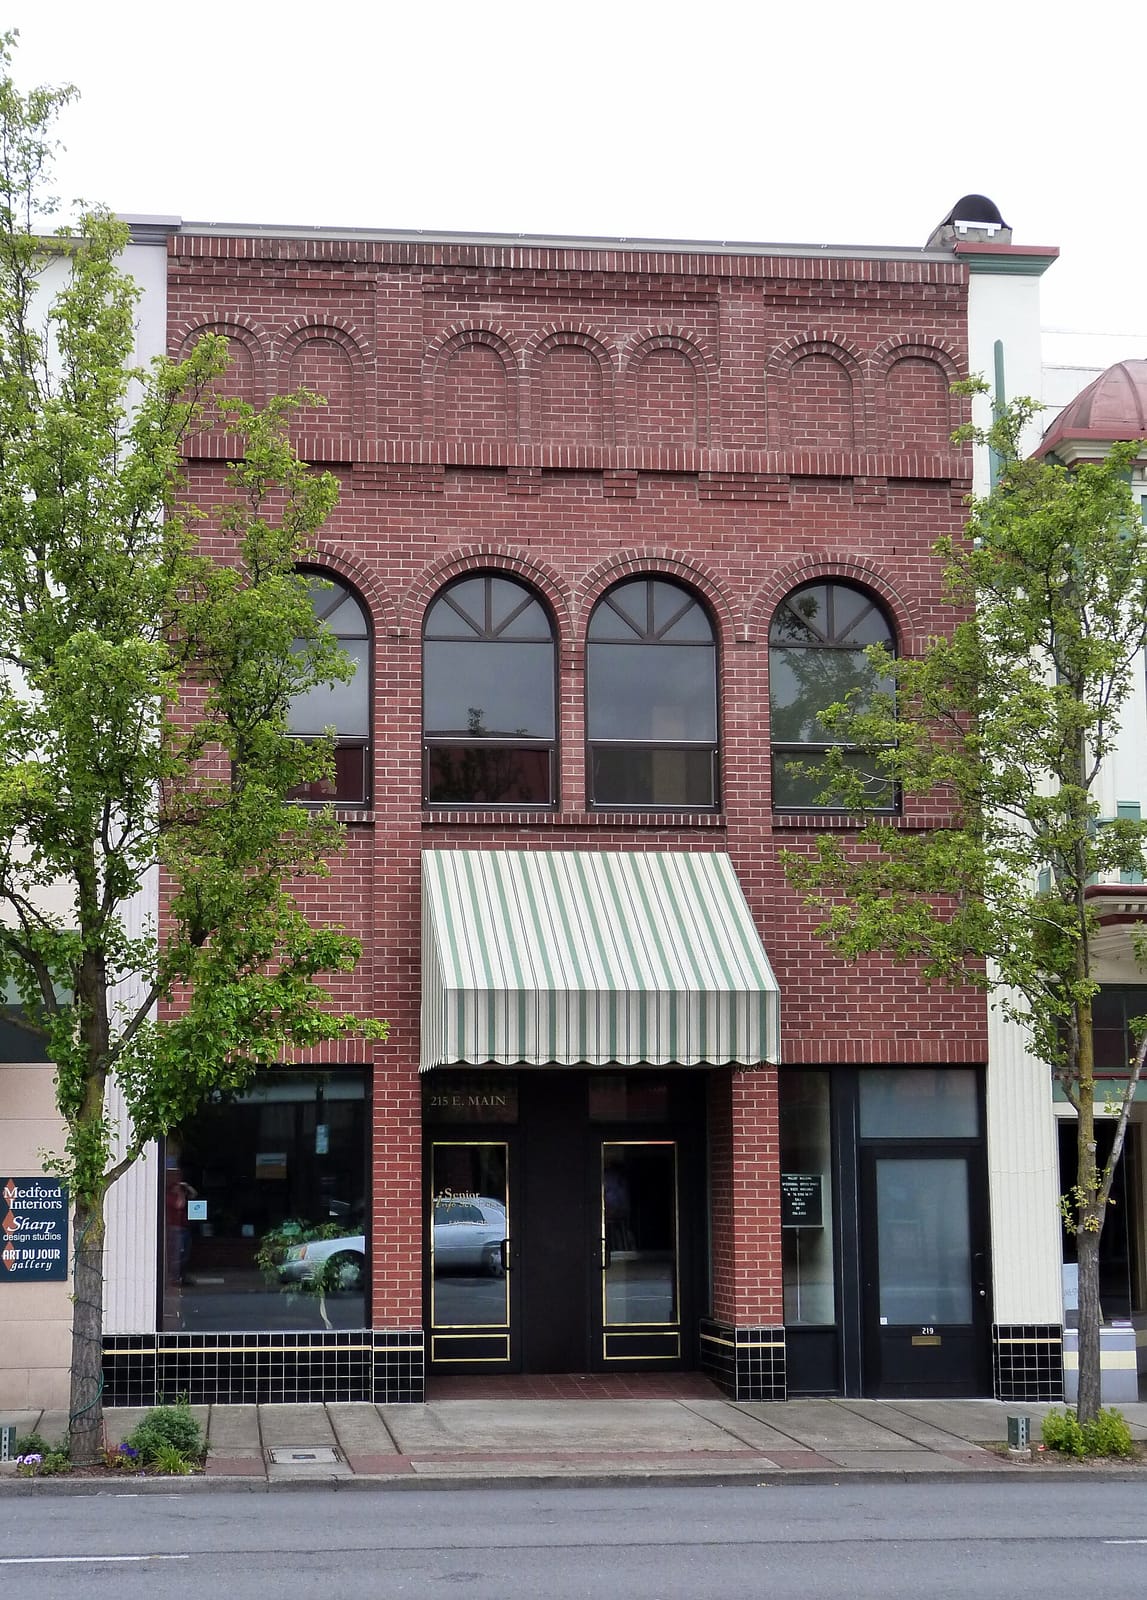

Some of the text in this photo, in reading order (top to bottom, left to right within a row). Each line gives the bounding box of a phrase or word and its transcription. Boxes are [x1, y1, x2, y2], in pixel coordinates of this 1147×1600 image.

[431, 1096, 448, 1106] 215
[468, 1096, 506, 1106] MAIN
[4, 1186, 62, 1198] Medford
[445, 1187, 480, 1200] Senior
[10, 1199, 63, 1210] Interiors
[7, 1216, 56, 1233] Sharp
[3, 1232, 62, 1242] design studios
[3, 1249, 60, 1260] ART DU JOUR
[10, 1260, 52, 1271] gallery
